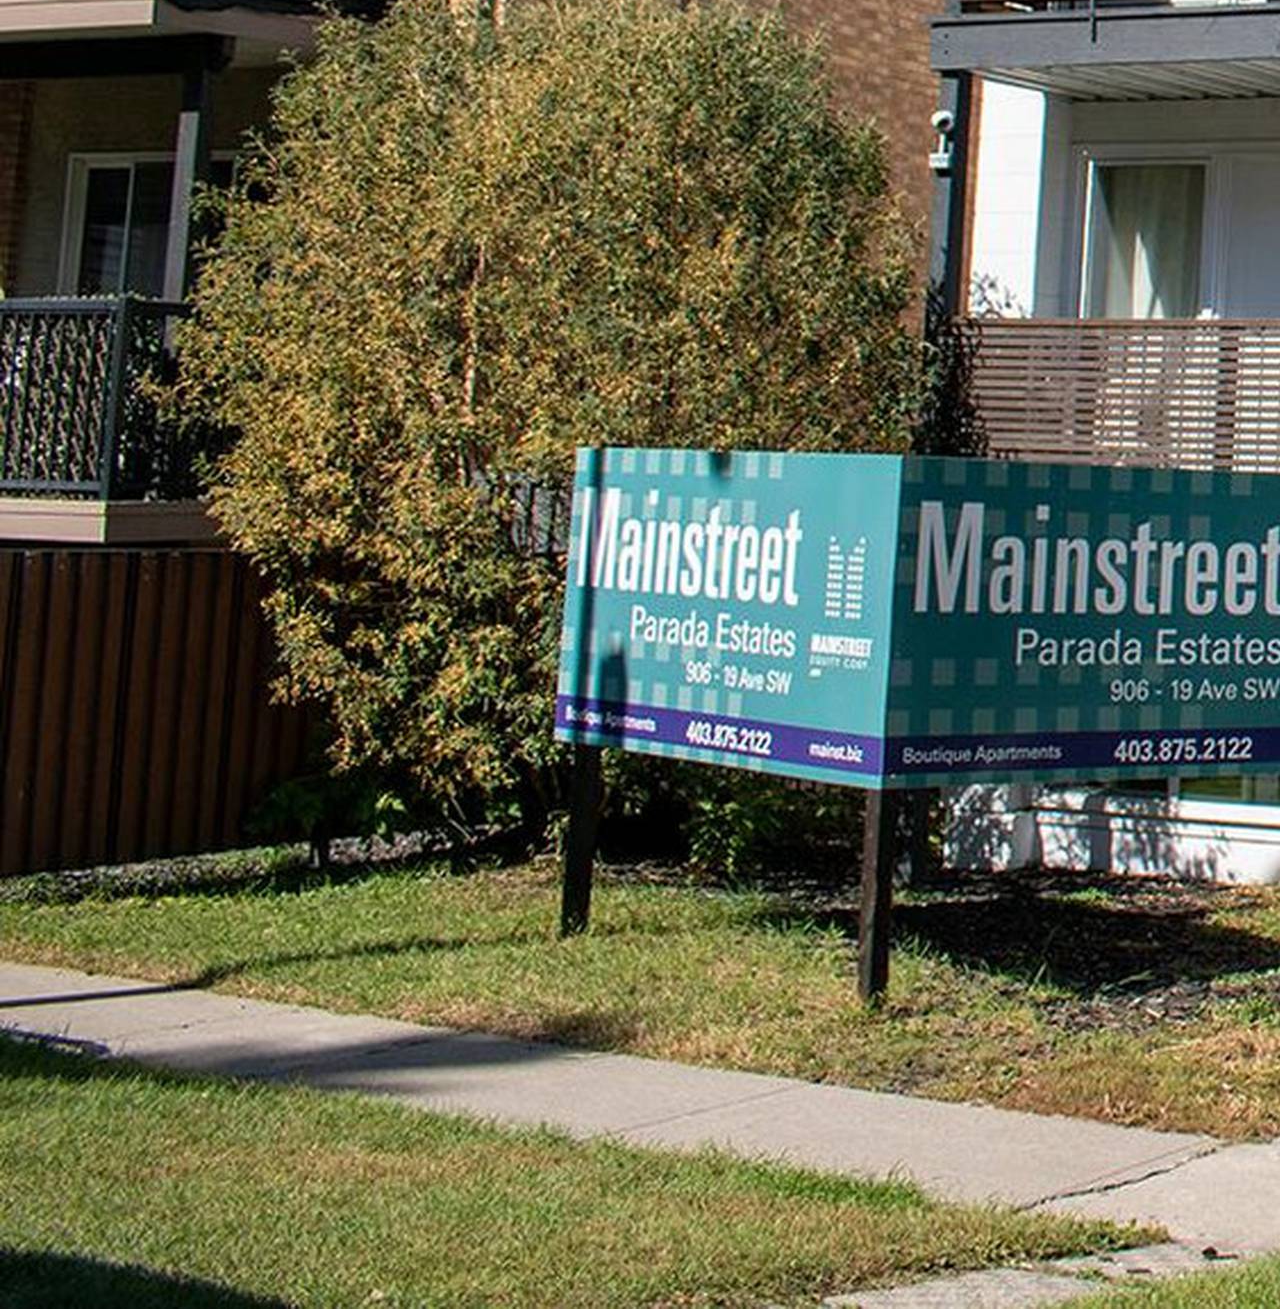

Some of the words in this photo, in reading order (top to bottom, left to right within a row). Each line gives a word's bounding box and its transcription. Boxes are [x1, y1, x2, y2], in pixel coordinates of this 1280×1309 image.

[576, 487, 803, 606] Mainstreet
[630, 605, 709, 648] Parada
[715, 612, 796, 658] Estates
[1015, 628, 1142, 666] Parada
[685, 660, 712, 684] 906
[724, 665, 739, 688] 19
[738, 667, 766, 692] Ave
[766, 669, 793, 695] SW
[1110, 678, 1149, 702] 906
[1170, 679, 1193, 701] 19
[1196, 679, 1237, 701] Ave
[1243, 678, 1280, 701] SW
[685, 720, 771, 756] 403.875.2122
[902, 746, 972, 766] Boutique
[974, 744, 1062, 764] Apartments
[1113, 736, 1253, 763] 403.875.2122
